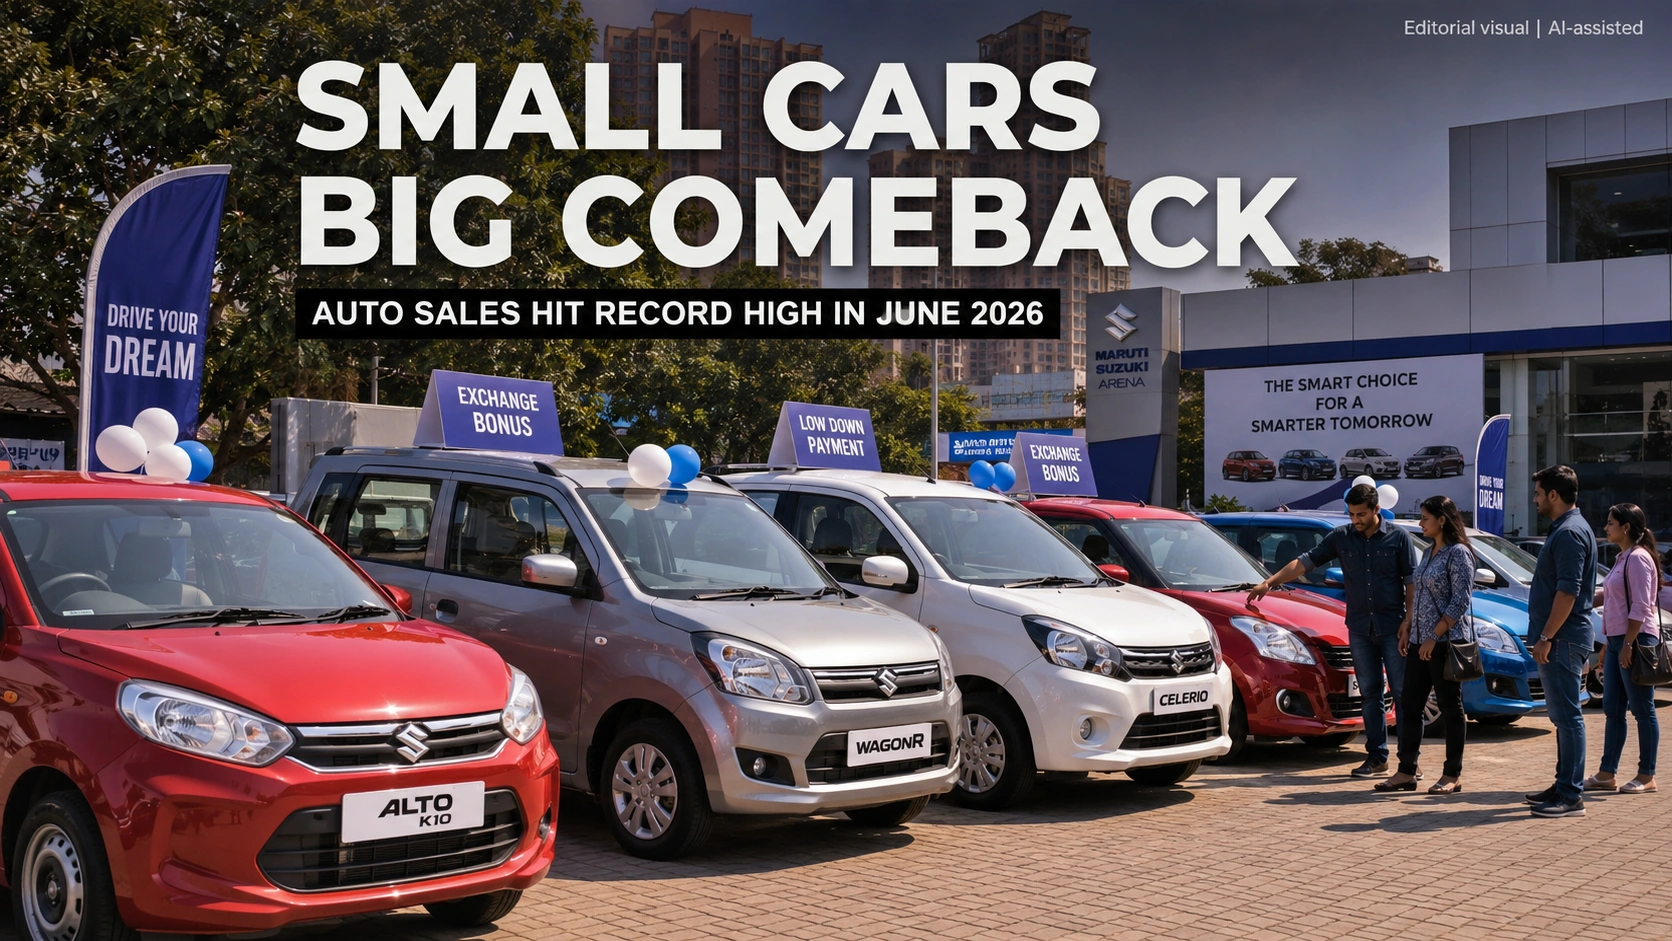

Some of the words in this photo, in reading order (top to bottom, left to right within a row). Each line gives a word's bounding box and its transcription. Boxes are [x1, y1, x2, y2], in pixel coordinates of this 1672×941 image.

[107, 303, 155, 331] DRIVE
[159, 309, 199, 335] YOUR
[104, 334, 196, 381] DREAM
[1095, 347, 1149, 361] MARUTI
[1095, 361, 1149, 375] SUZUKI
[1098, 377, 1146, 389] ARENA
[1264, 379, 1294, 393] THE
[1298, 376, 1352, 392] SMART
[1356, 372, 1418, 388] CHOICE
[457, 386, 540, 412] EXCHANGE
[1315, 397, 1347, 411] FOR
[1352, 395, 1364, 409] A
[472, 411, 533, 437] BONUS
[799, 414, 827, 432] LOW
[828, 417, 865, 435] DOWN
[1251, 417, 1325, 433] SMARTER
[1330, 413, 1433, 430] TOMORROW
[807, 436, 865, 457] PAYMENT
[1029, 444, 1083, 462] EXCHANGE
[1042, 464, 1080, 483] BONUS
[1479, 489, 1503, 510] DREAM
[1159, 690, 1209, 707] CELERIO
[856, 733, 924, 755] WAGONR
[378, 793, 453, 818] ALTO
[419, 813, 452, 828] K10
